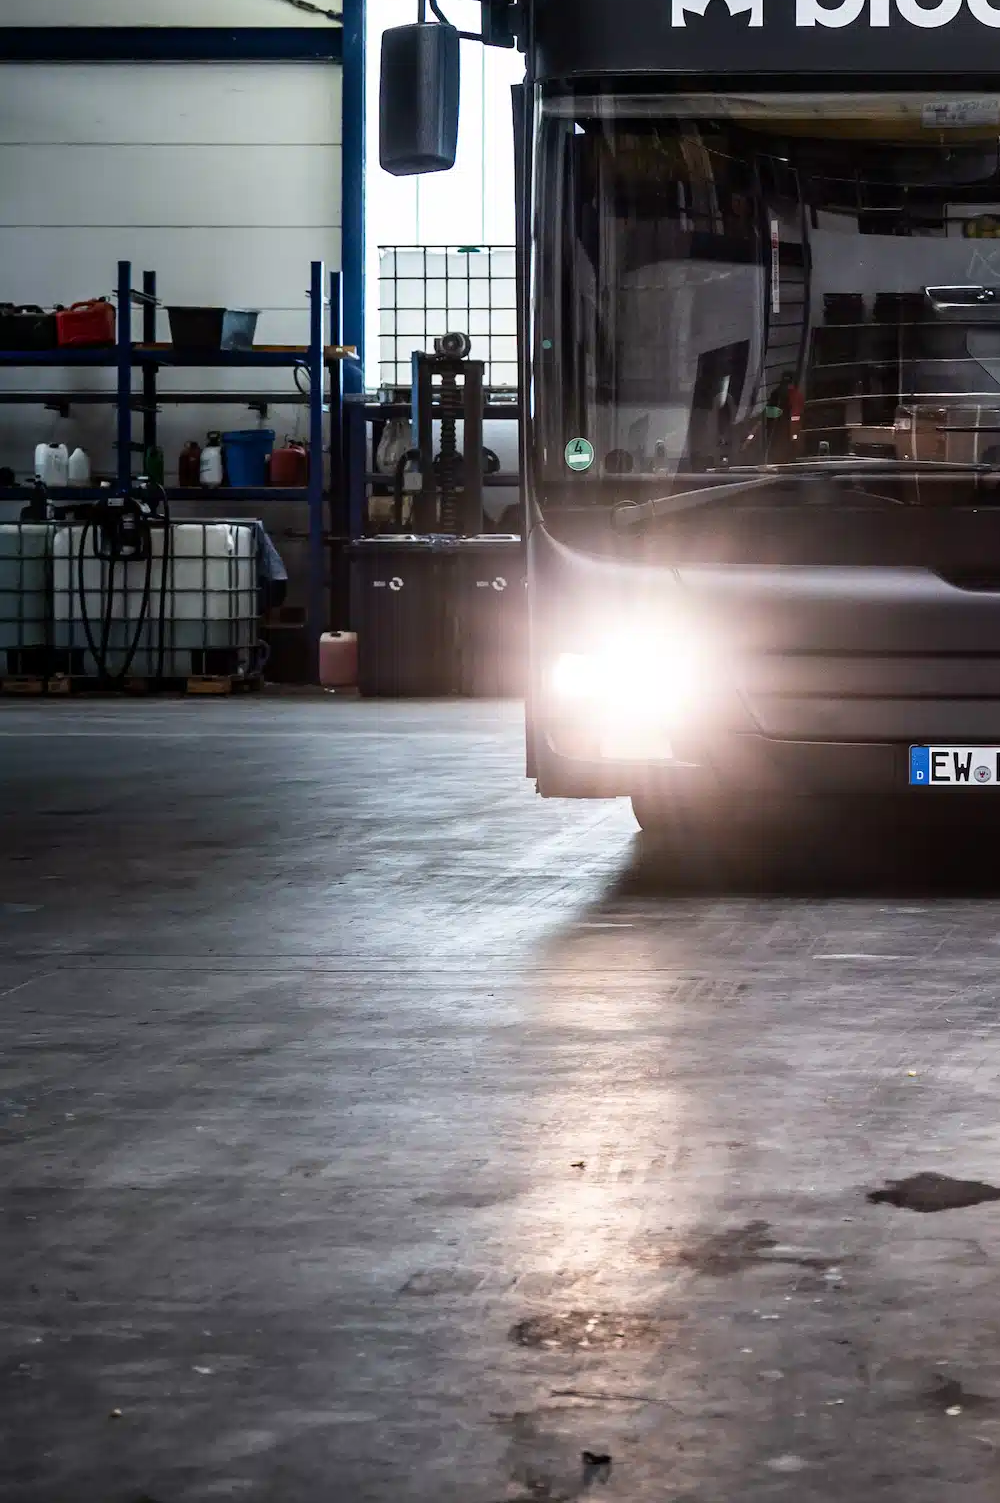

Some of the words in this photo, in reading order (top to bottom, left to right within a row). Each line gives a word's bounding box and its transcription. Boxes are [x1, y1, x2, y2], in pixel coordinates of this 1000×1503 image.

[574, 440, 583, 454] 4
[916, 770, 924, 780] D
[931, 751, 973, 782] EW
